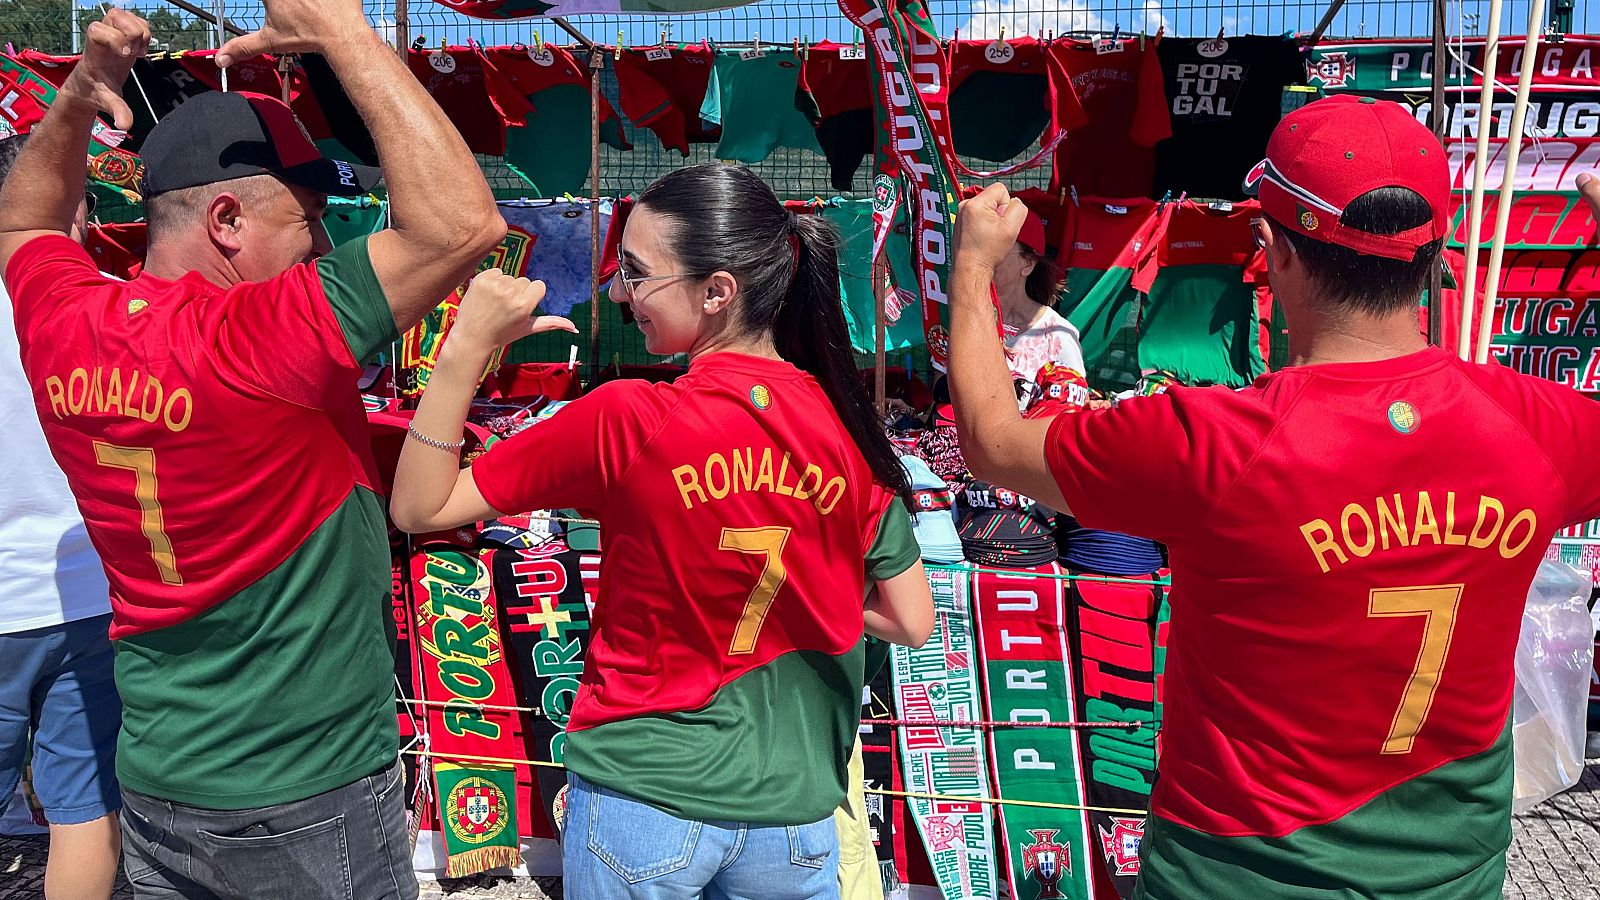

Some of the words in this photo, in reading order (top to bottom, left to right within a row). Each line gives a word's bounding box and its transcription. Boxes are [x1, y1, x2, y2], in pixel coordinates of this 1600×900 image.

[432, 56, 453, 68] 20€
[989, 47, 1010, 59] 25€
[1202, 42, 1224, 52] 20€
[1176, 78, 1219, 95] TU
[1177, 63, 1243, 80] POR
[1173, 95, 1232, 116] GAL
[46, 367, 193, 432] RONALDO
[672, 447, 847, 515] RONALDO
[93, 440, 184, 587] 7
[1300, 491, 1537, 573] RONALDO
[718, 525, 792, 656] 7
[1367, 583, 1465, 755] 7
[910, 753, 926, 787] VALENTE
[962, 814, 986, 849] POVO
[945, 849, 959, 872] MAR
[967, 853, 992, 898] NOBRE
